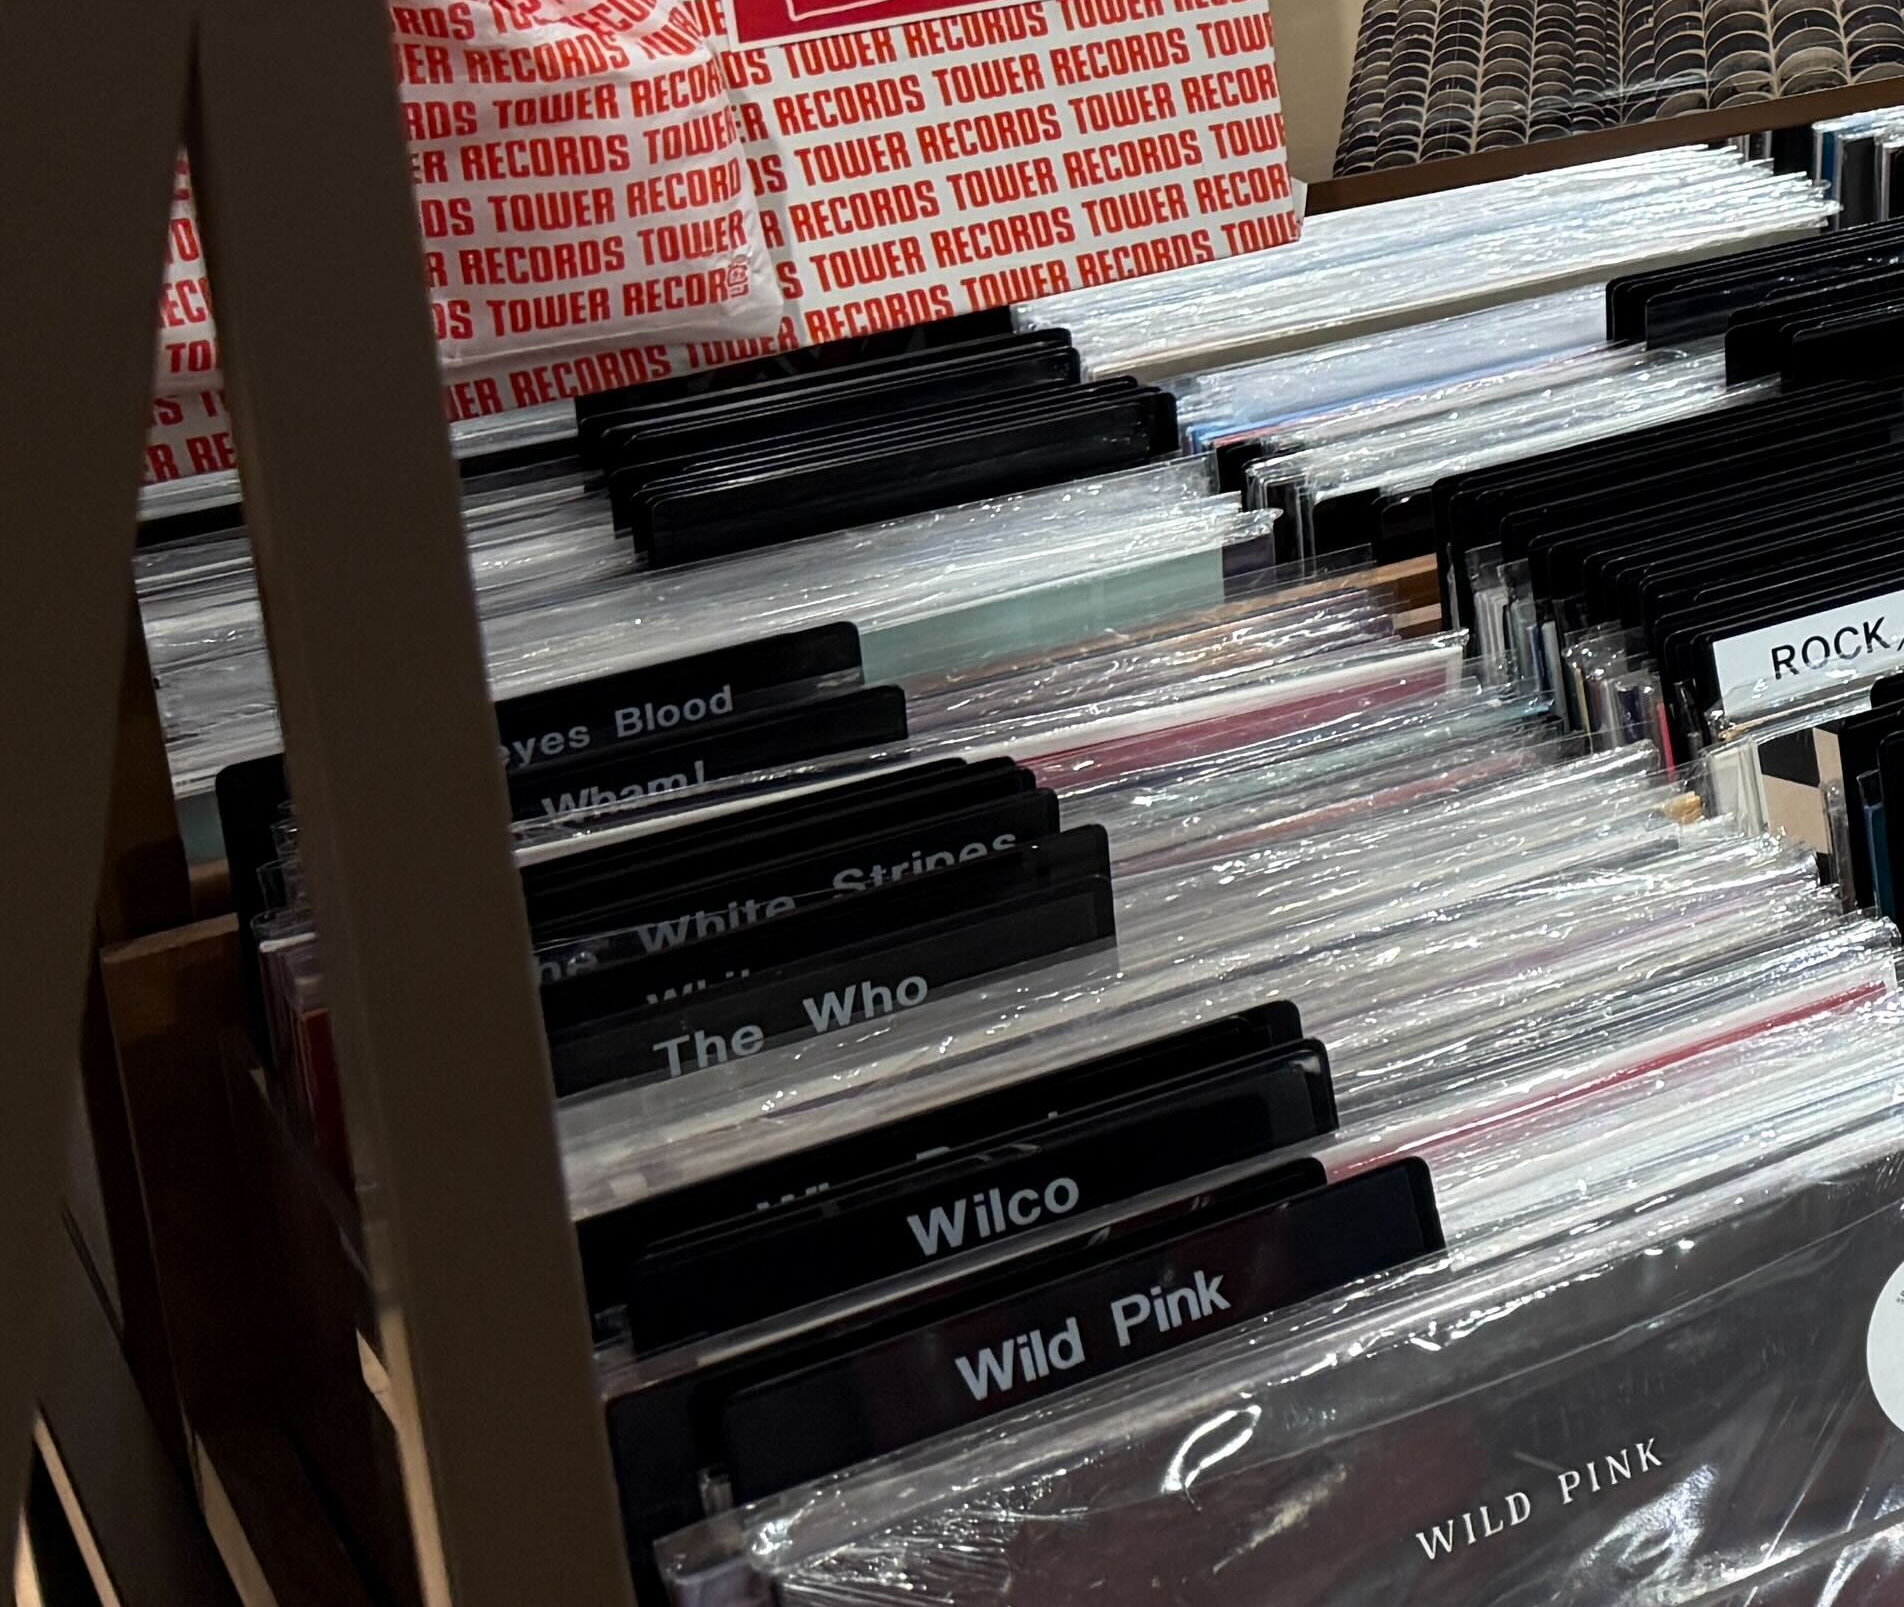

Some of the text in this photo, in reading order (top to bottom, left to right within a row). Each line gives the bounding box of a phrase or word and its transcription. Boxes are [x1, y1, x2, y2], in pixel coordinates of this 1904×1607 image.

[796, 85, 1175, 184] TOWER RECORDS TOWER
[616, 685, 734, 739] Blood
[542, 760, 704, 822] Wham!
[633, 831, 1017, 955] White Stripes
[652, 975, 929, 1079] The Who
[906, 1177, 1081, 1256] Wilco
[954, 1269, 1232, 1402] Wild Pink
[1416, 1438, 1664, 1561] WILD PINK
